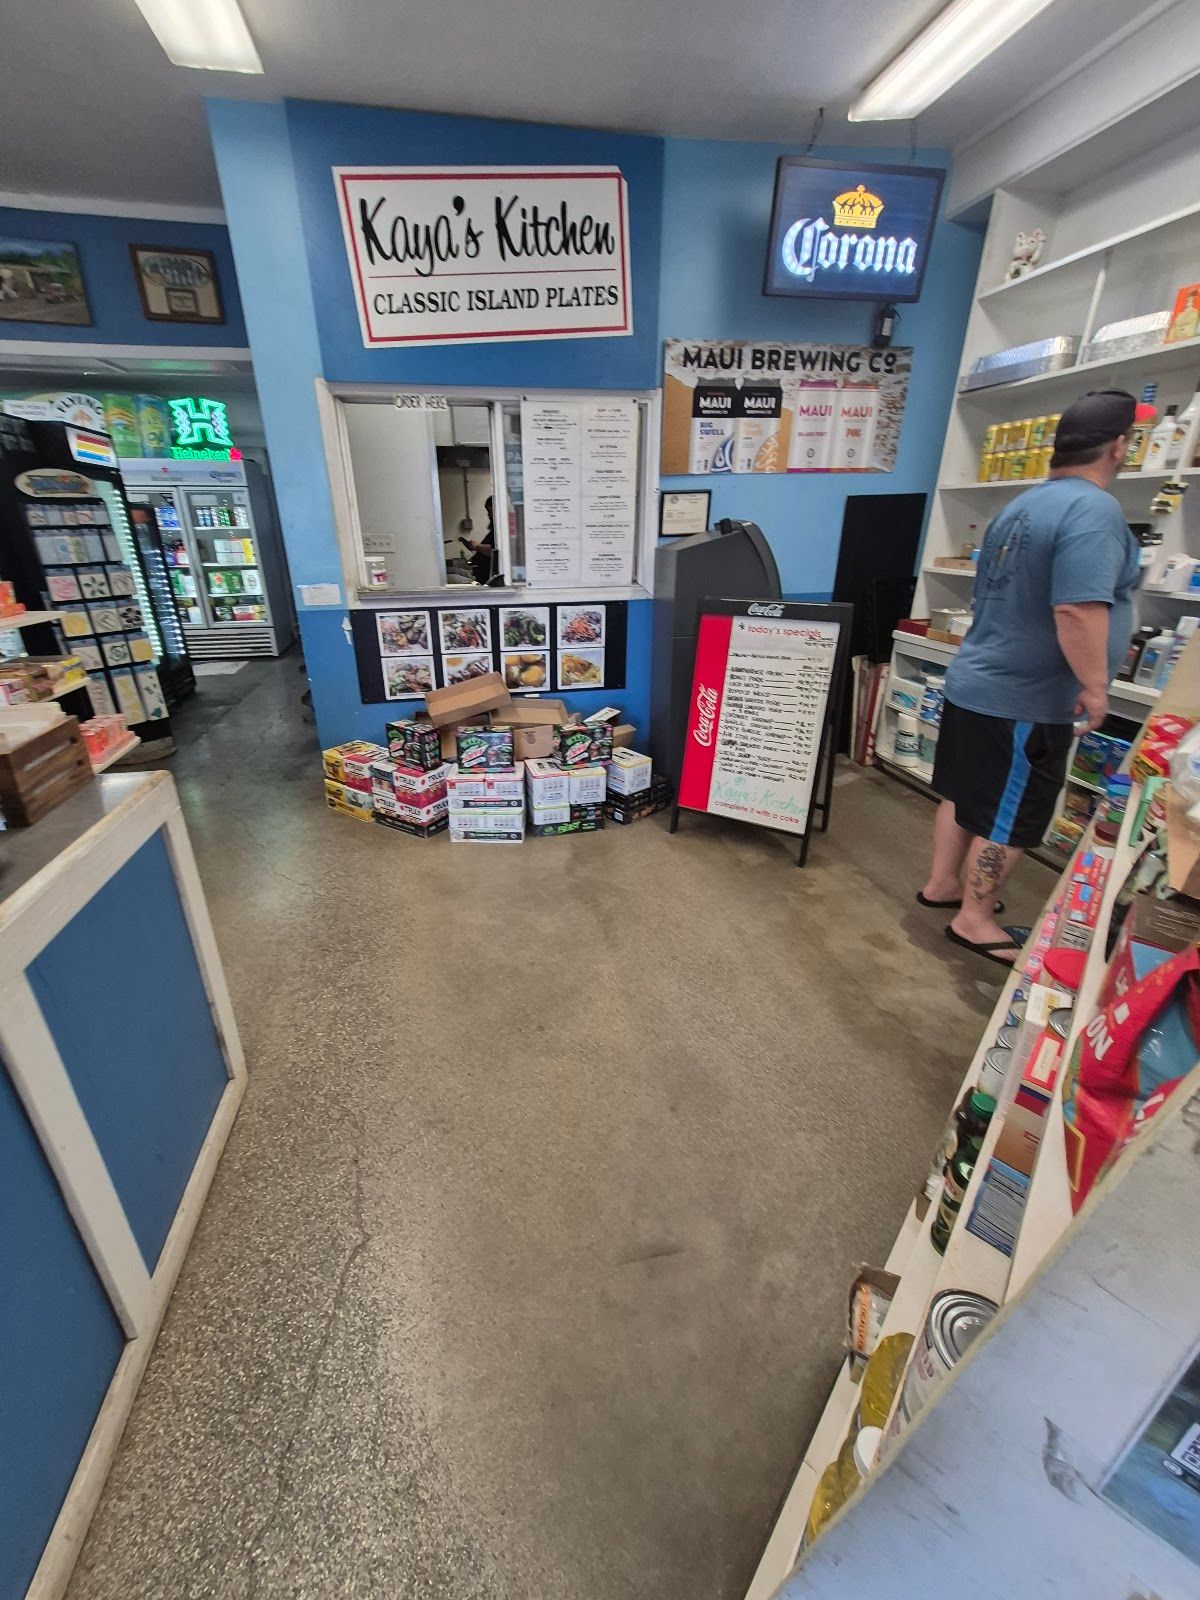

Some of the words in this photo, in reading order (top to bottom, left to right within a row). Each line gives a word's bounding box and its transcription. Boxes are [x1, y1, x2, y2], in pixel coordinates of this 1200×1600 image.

[359, 195, 484, 277] Kaya's
[495, 195, 615, 262] Kitchen
[781, 216, 919, 283] Corona
[373, 290, 462, 315] CLASSIC
[466, 287, 540, 311] ISLAND
[545, 285, 619, 309] PLATES
[682, 346, 743, 370] MAUI
[751, 348, 862, 373] BREWING
[425, 395, 448, 410] HERE
[699, 397, 732, 409] MAUI
[744, 397, 776, 409] MAUI
[799, 404, 832, 417] MAUI
[841, 406, 873, 418] MAUI
[170, 446, 230, 461] Heineken
[747, 624, 781, 636] today's
[782, 628, 822, 639] specials
[399, 775, 417, 787] TRULY
[427, 769, 446, 783] TRULY
[404, 805, 421, 816] TRULY
[714, 800, 748, 813] complete
